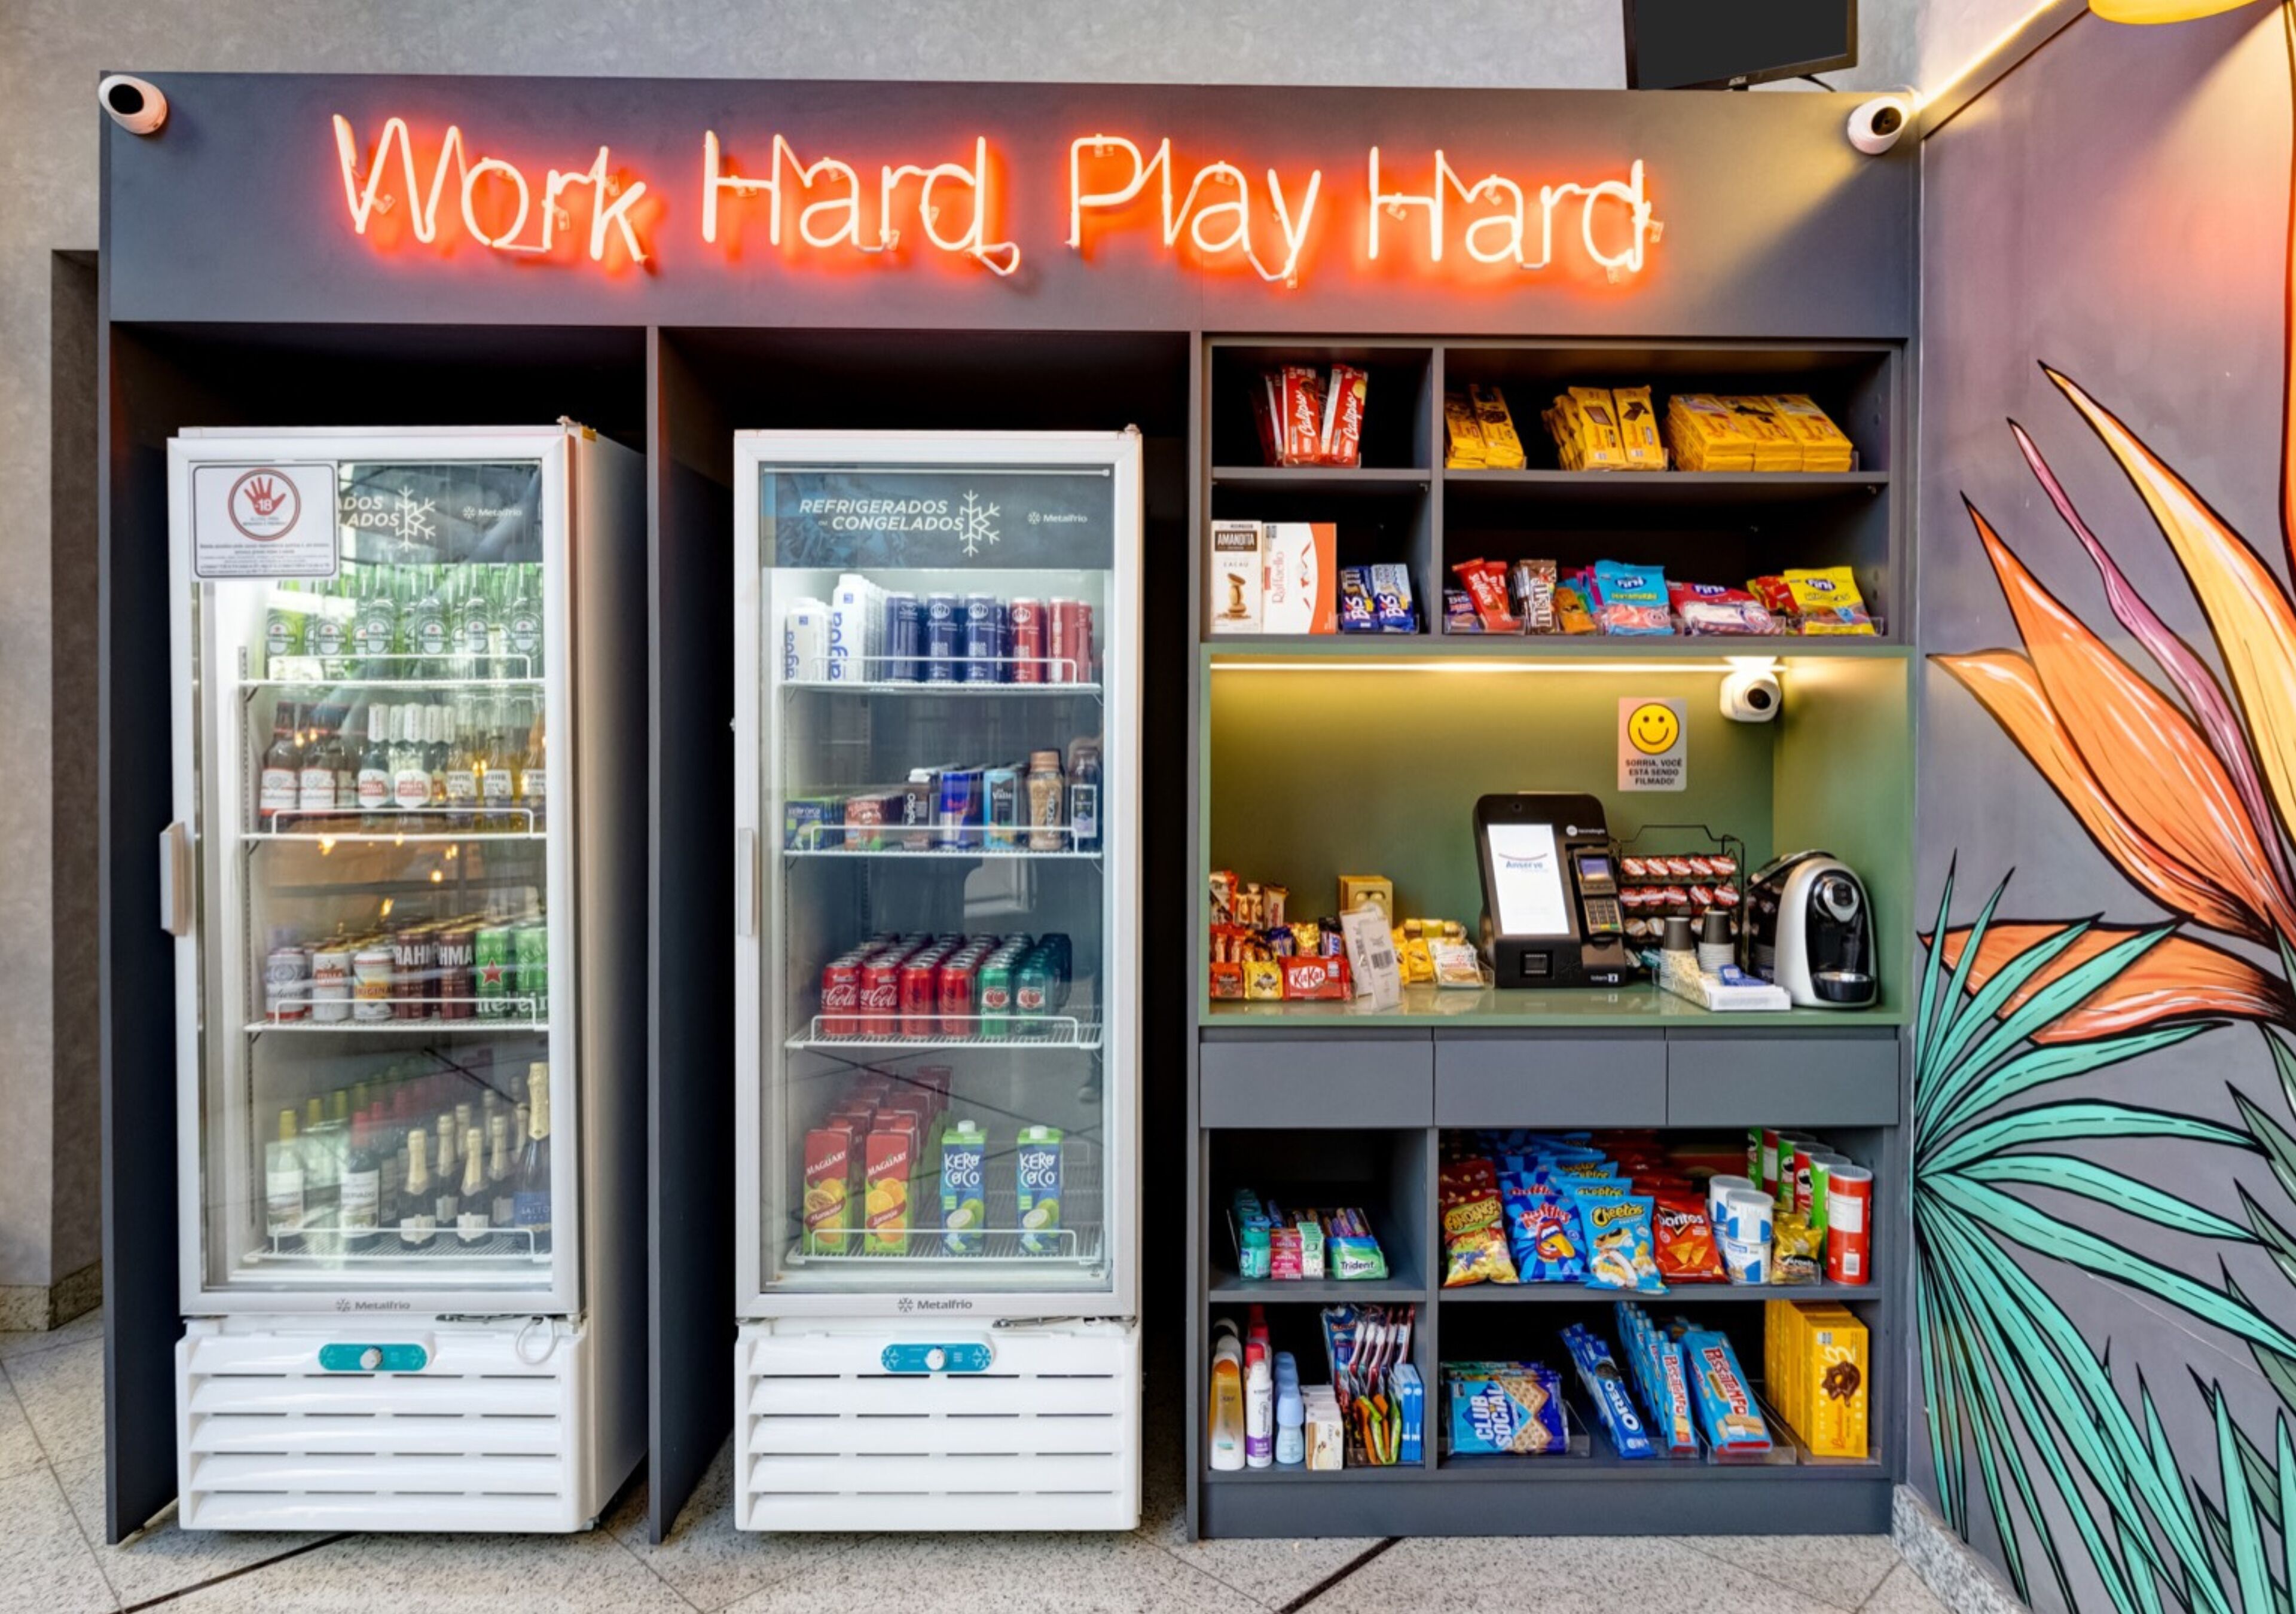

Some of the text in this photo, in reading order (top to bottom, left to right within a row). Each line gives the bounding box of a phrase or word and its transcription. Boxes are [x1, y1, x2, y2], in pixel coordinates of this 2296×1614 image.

[332, 114, 648, 261] Work
[1068, 136, 1321, 281] Play
[1368, 146, 1649, 273] Hard
[799, 499, 948, 515] REFRIGERADOS
[832, 516, 965, 531] CONGELADOS
[1042, 513, 1088, 523] Metalfrio
[1626, 759, 1658, 768] SORRIA,
[806, 1151, 847, 1175] MAGUARY
[867, 1151, 907, 1176] MAGUARY
[1519, 1202, 1572, 1228] Ruffles
[1592, 1202, 1644, 1227] Cheetos
[1657, 1210, 1704, 1227] Doritos
[1340, 1261, 1375, 1269] Trident
[355, 1300, 410, 1310] Metalfrio
[917, 1299, 973, 1310] Metalfrio
[1605, 1381, 1640, 1430] OREO
[1470, 1395, 1494, 1441] CLUB
[1488, 1386, 1513, 1447] SOCIAL
